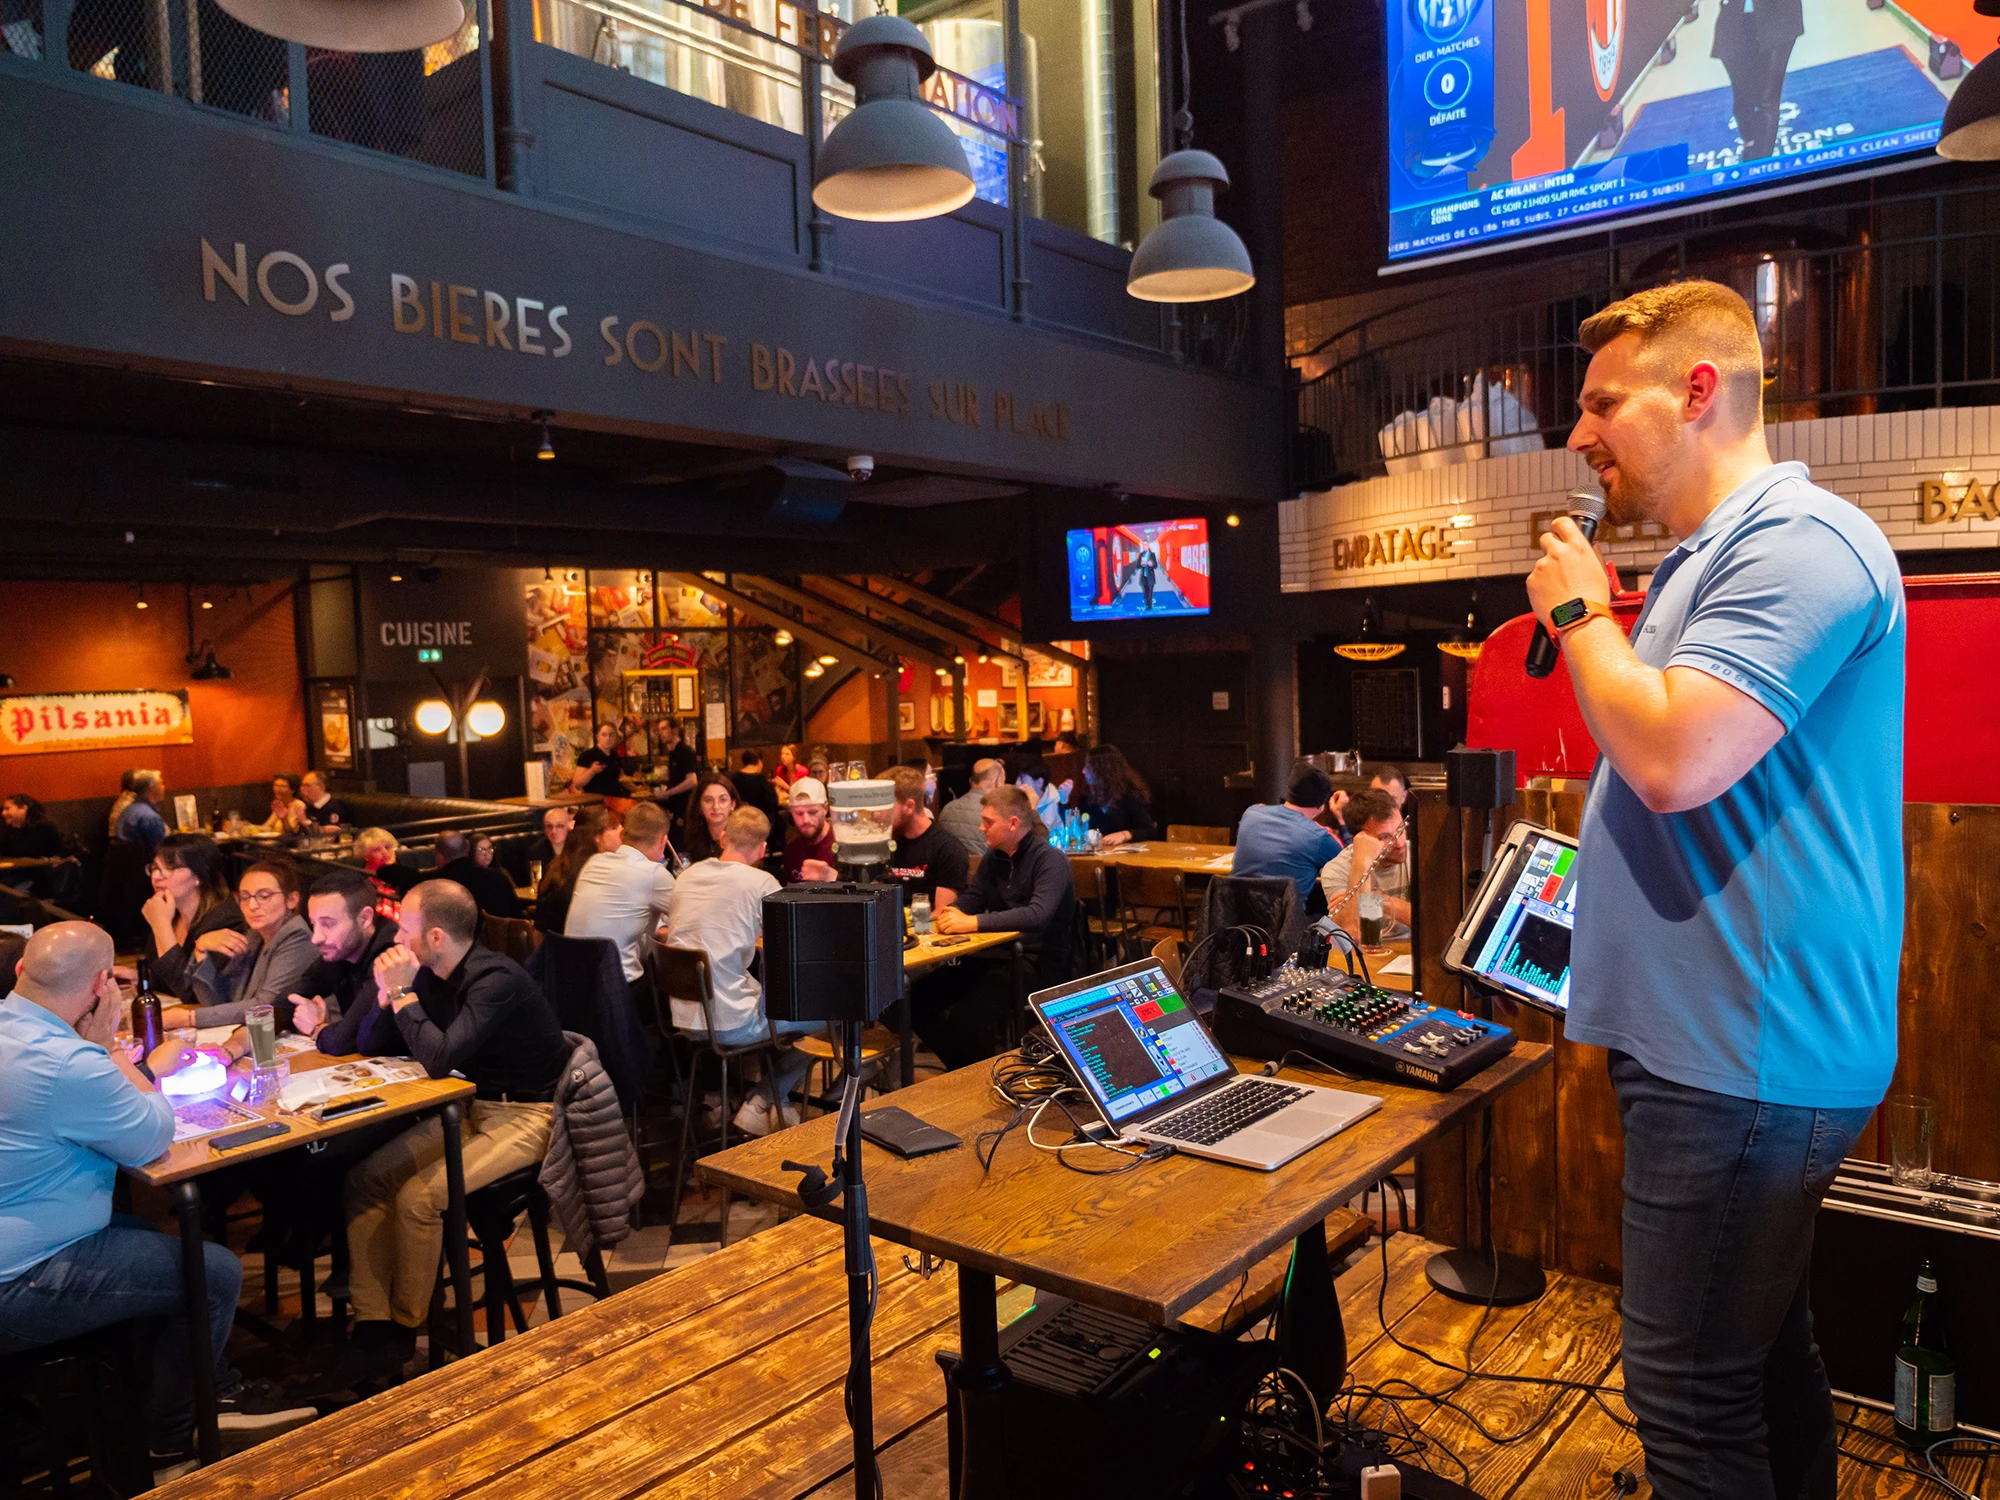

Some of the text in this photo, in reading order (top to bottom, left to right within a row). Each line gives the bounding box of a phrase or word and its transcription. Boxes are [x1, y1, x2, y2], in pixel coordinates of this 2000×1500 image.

[1436, 36, 1480, 57] MATCHES
[1441, 73, 1455, 94] 0
[1429, 107, 1467, 126] DÉFAITE
[1748, 160, 1781, 176] INTER
[1793, 157, 1802, 168] A
[1805, 146, 1845, 164] GARDÉ
[1861, 137, 1899, 154] CLEAN
[1490, 189, 1504, 202] AC
[1505, 182, 1537, 198] MILAN
[1544, 173, 1575, 188] INTER
[1490, 206, 1502, 216] CE
[1502, 201, 1522, 214] SOIR
[1522, 195, 1550, 210] 21H00
[1550, 191, 1568, 203] SUR
[1568, 186, 1588, 199] RMC
[1589, 179, 1618, 195] SPORT
[1431, 198, 1480, 217] CHAMPIONS
[1431, 214, 1453, 226] ZONE
[1412, 232, 1451, 248] MATCHES
[1453, 229, 1466, 240] DE
[200, 237, 1072, 441] NOS BIERES SONT BRASSEES SUR PLACE
[1919, 477, 2000, 525] BA
[1333, 525, 1456, 572] EMPATAGE
[380, 622, 473, 646] CUISINE
[1710, 662, 1756, 690] BOSS
[1405, 1063, 1439, 1084] YAMAHA
